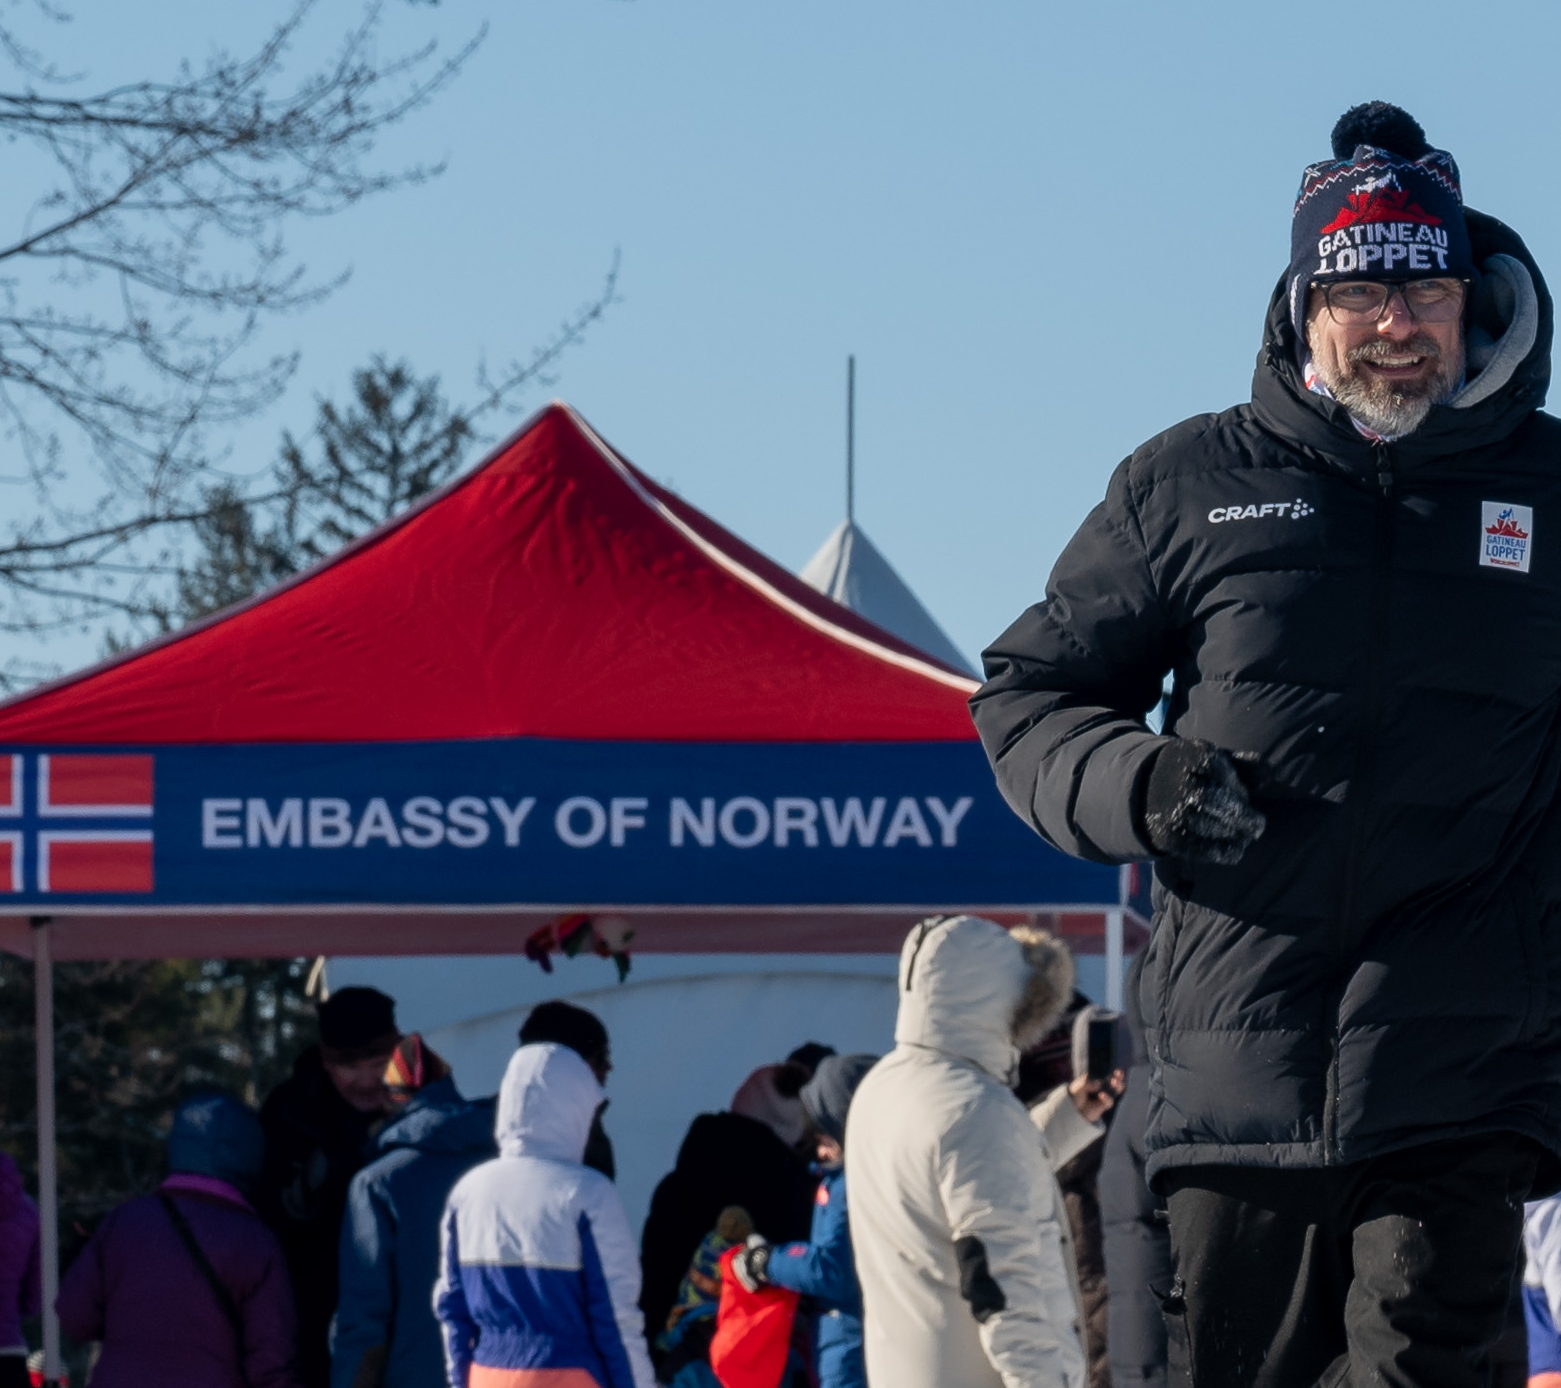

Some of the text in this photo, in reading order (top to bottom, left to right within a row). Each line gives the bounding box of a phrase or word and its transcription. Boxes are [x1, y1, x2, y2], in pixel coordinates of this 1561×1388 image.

[1318, 223, 1448, 257] GATINEAU
[1314, 244, 1448, 275] LOPPET
[1207, 502, 1292, 524] CRAFT
[1485, 544, 1526, 562] LOPPET
[1486, 535, 1526, 549] GATINEAU
[202, 797, 973, 849] EMBASSY OF NORWAY
